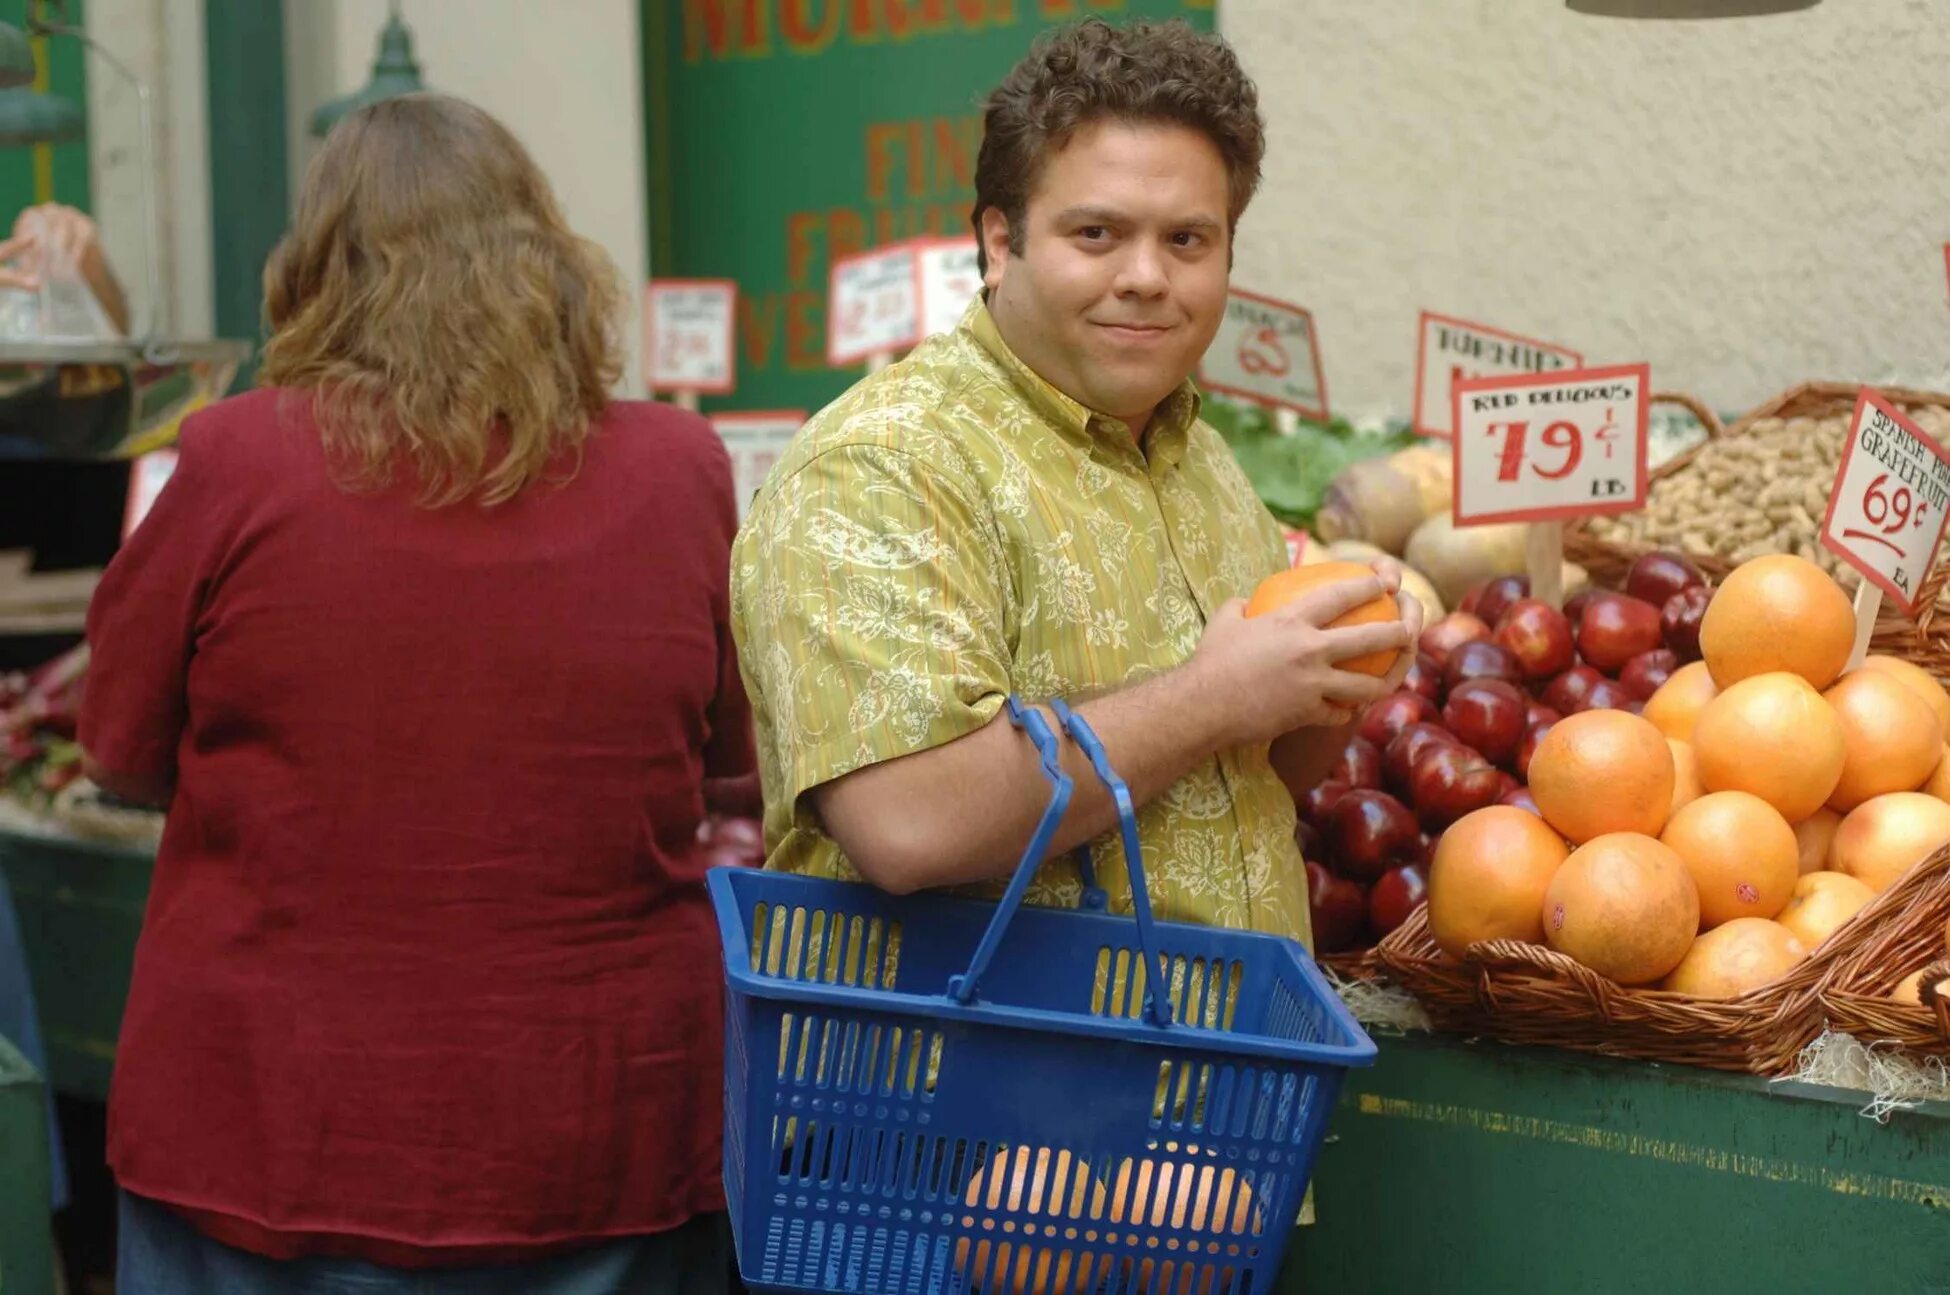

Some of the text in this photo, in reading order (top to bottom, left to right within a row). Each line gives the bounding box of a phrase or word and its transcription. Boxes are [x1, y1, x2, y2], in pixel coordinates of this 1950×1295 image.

[1472, 392, 1518, 412] RED
[1861, 427, 1949, 511] GRAPEFRUIT
[1872, 408, 1950, 488] SPANISH PIN
[1893, 567, 1909, 595] EA
